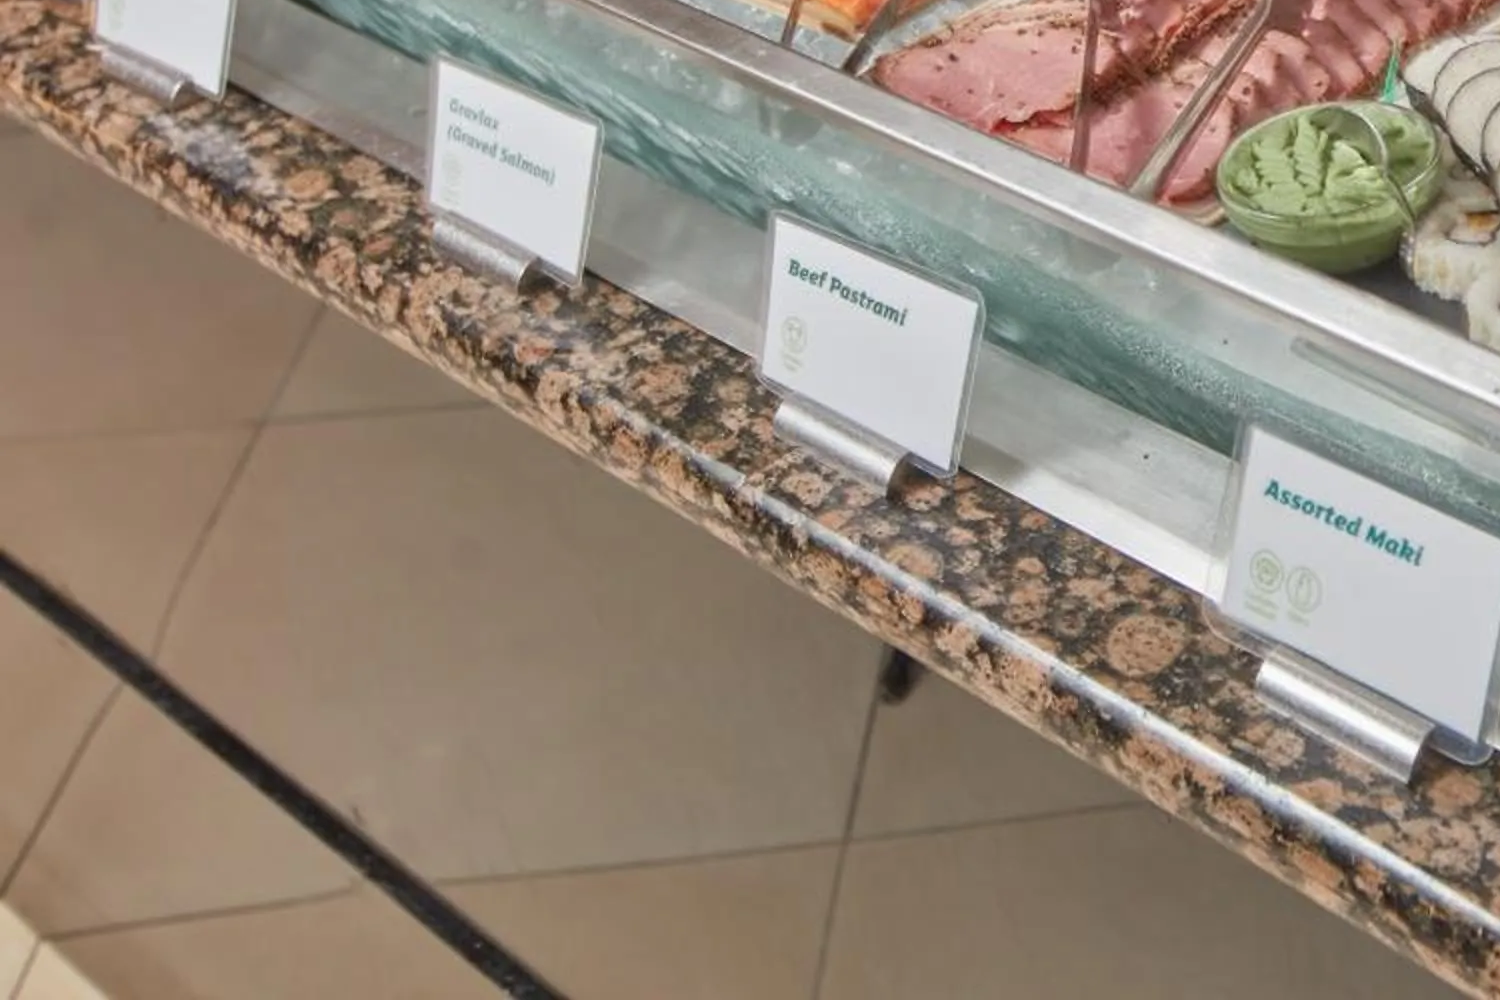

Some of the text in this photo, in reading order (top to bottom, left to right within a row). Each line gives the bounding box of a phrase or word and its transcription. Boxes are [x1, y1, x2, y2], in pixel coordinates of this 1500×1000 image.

[449, 98, 498, 130] Gravlax
[447, 124, 556, 186] (Graved Salmon)
[788, 258, 909, 327] Beef Pastrami
[1264, 478, 1425, 567] Assorted Maki
